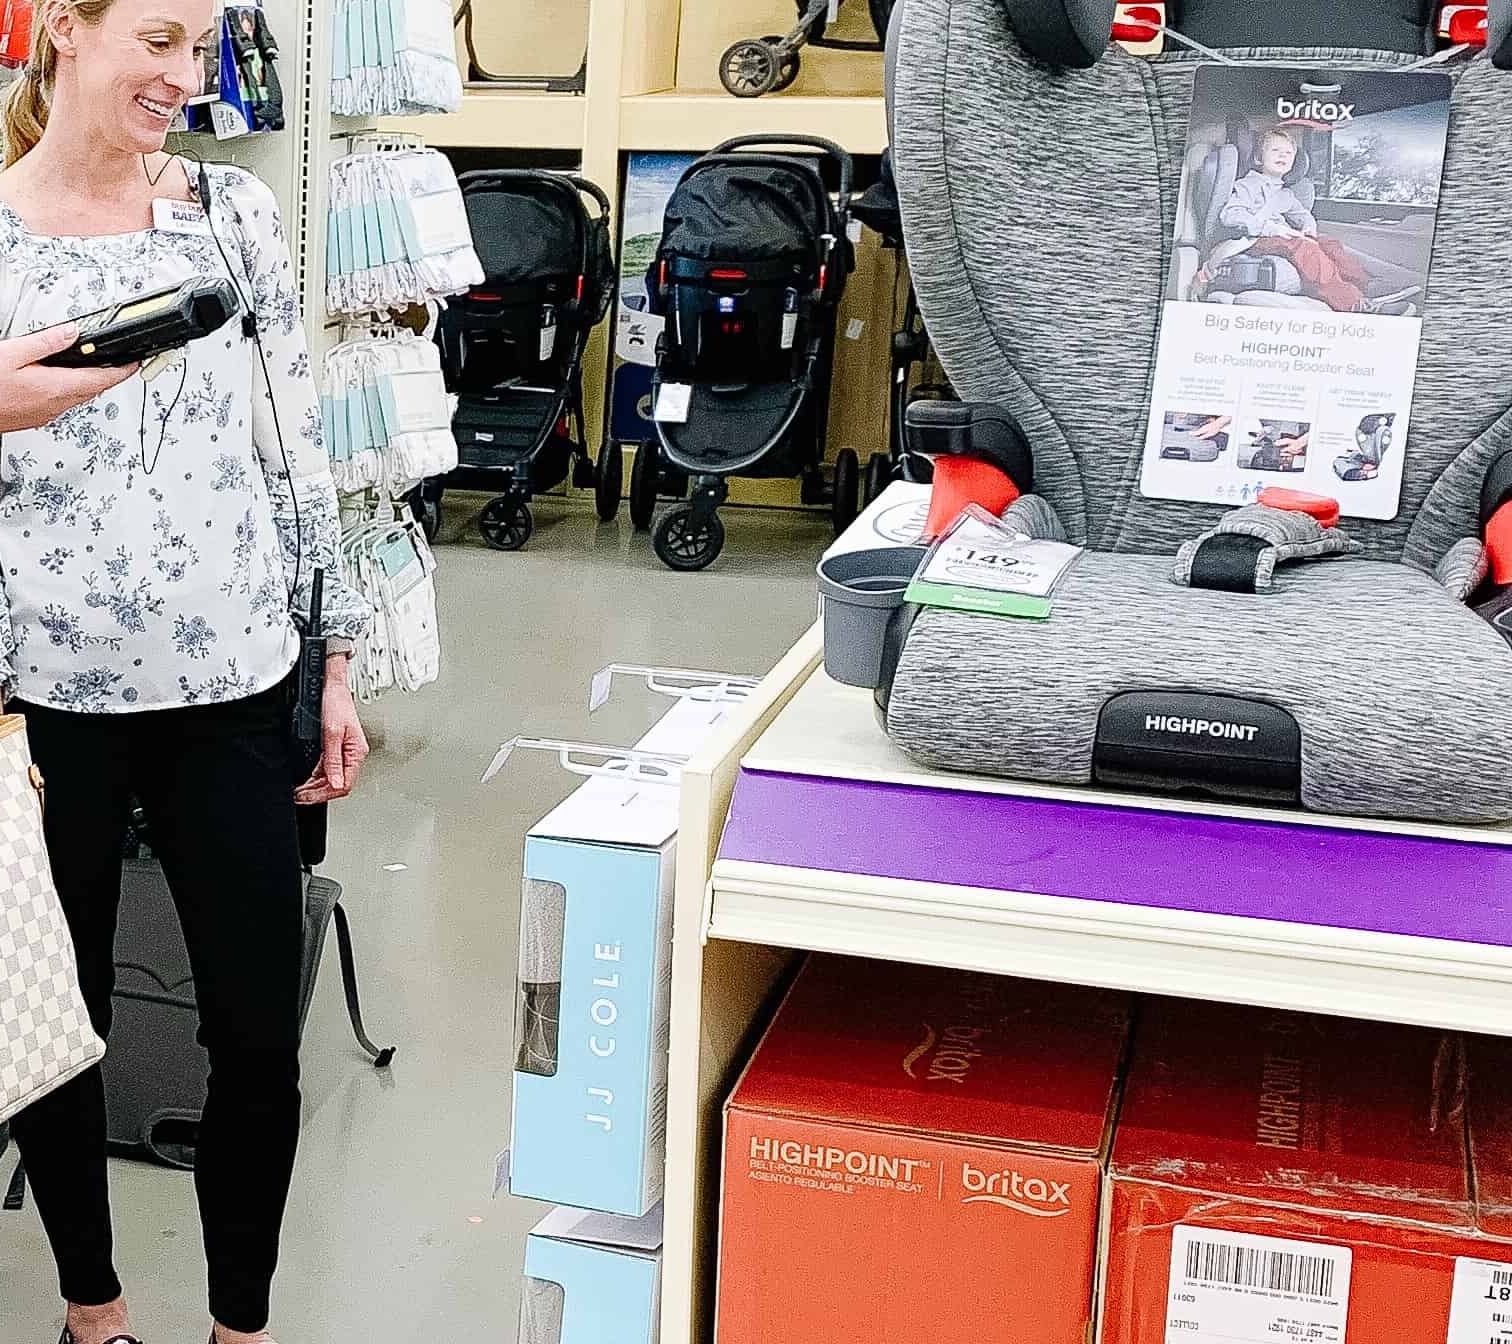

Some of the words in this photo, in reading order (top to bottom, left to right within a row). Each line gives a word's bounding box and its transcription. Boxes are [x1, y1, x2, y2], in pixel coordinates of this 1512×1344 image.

[1277, 96, 1355, 123] britax
[1204, 314, 1230, 332] Big
[1234, 315, 1284, 335] Safety
[1288, 319, 1306, 334] for
[1312, 321, 1337, 339] Big
[1341, 323, 1376, 338] Kids
[1193, 352, 1290, 371] Belt-Positioning
[1293, 359, 1341, 373] Booster
[1346, 363, 1375, 377] Seat
[1145, 714, 1258, 741] HIGHPOINT
[585, 1086, 615, 1132] JJ
[896, 1178, 924, 1194] SEAT
[961, 1163, 1071, 1205] britax
